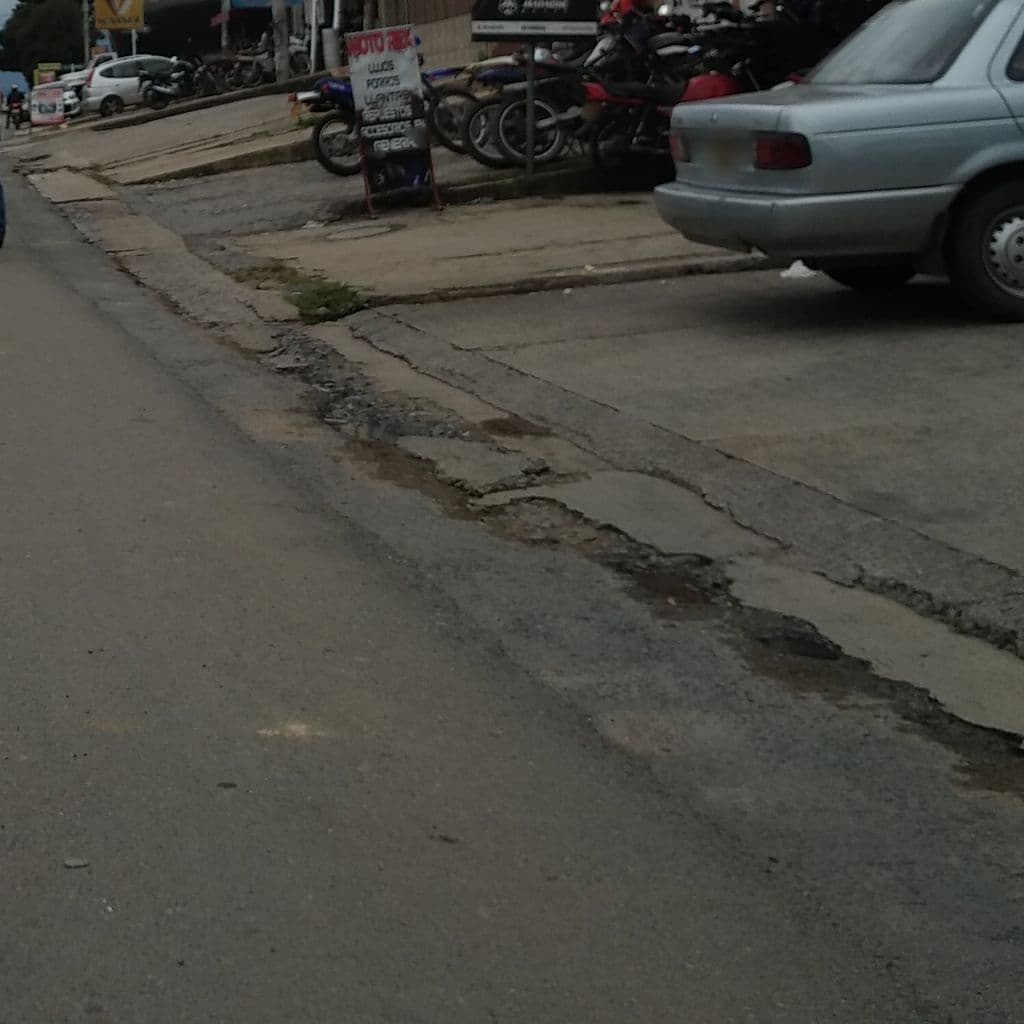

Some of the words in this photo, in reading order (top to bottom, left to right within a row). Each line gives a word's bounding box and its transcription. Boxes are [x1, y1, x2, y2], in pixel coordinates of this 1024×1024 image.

[367, 60, 394, 74] LUJOS
[366, 75, 401, 89] FORROS
[373, 136, 419, 152] GENERA
